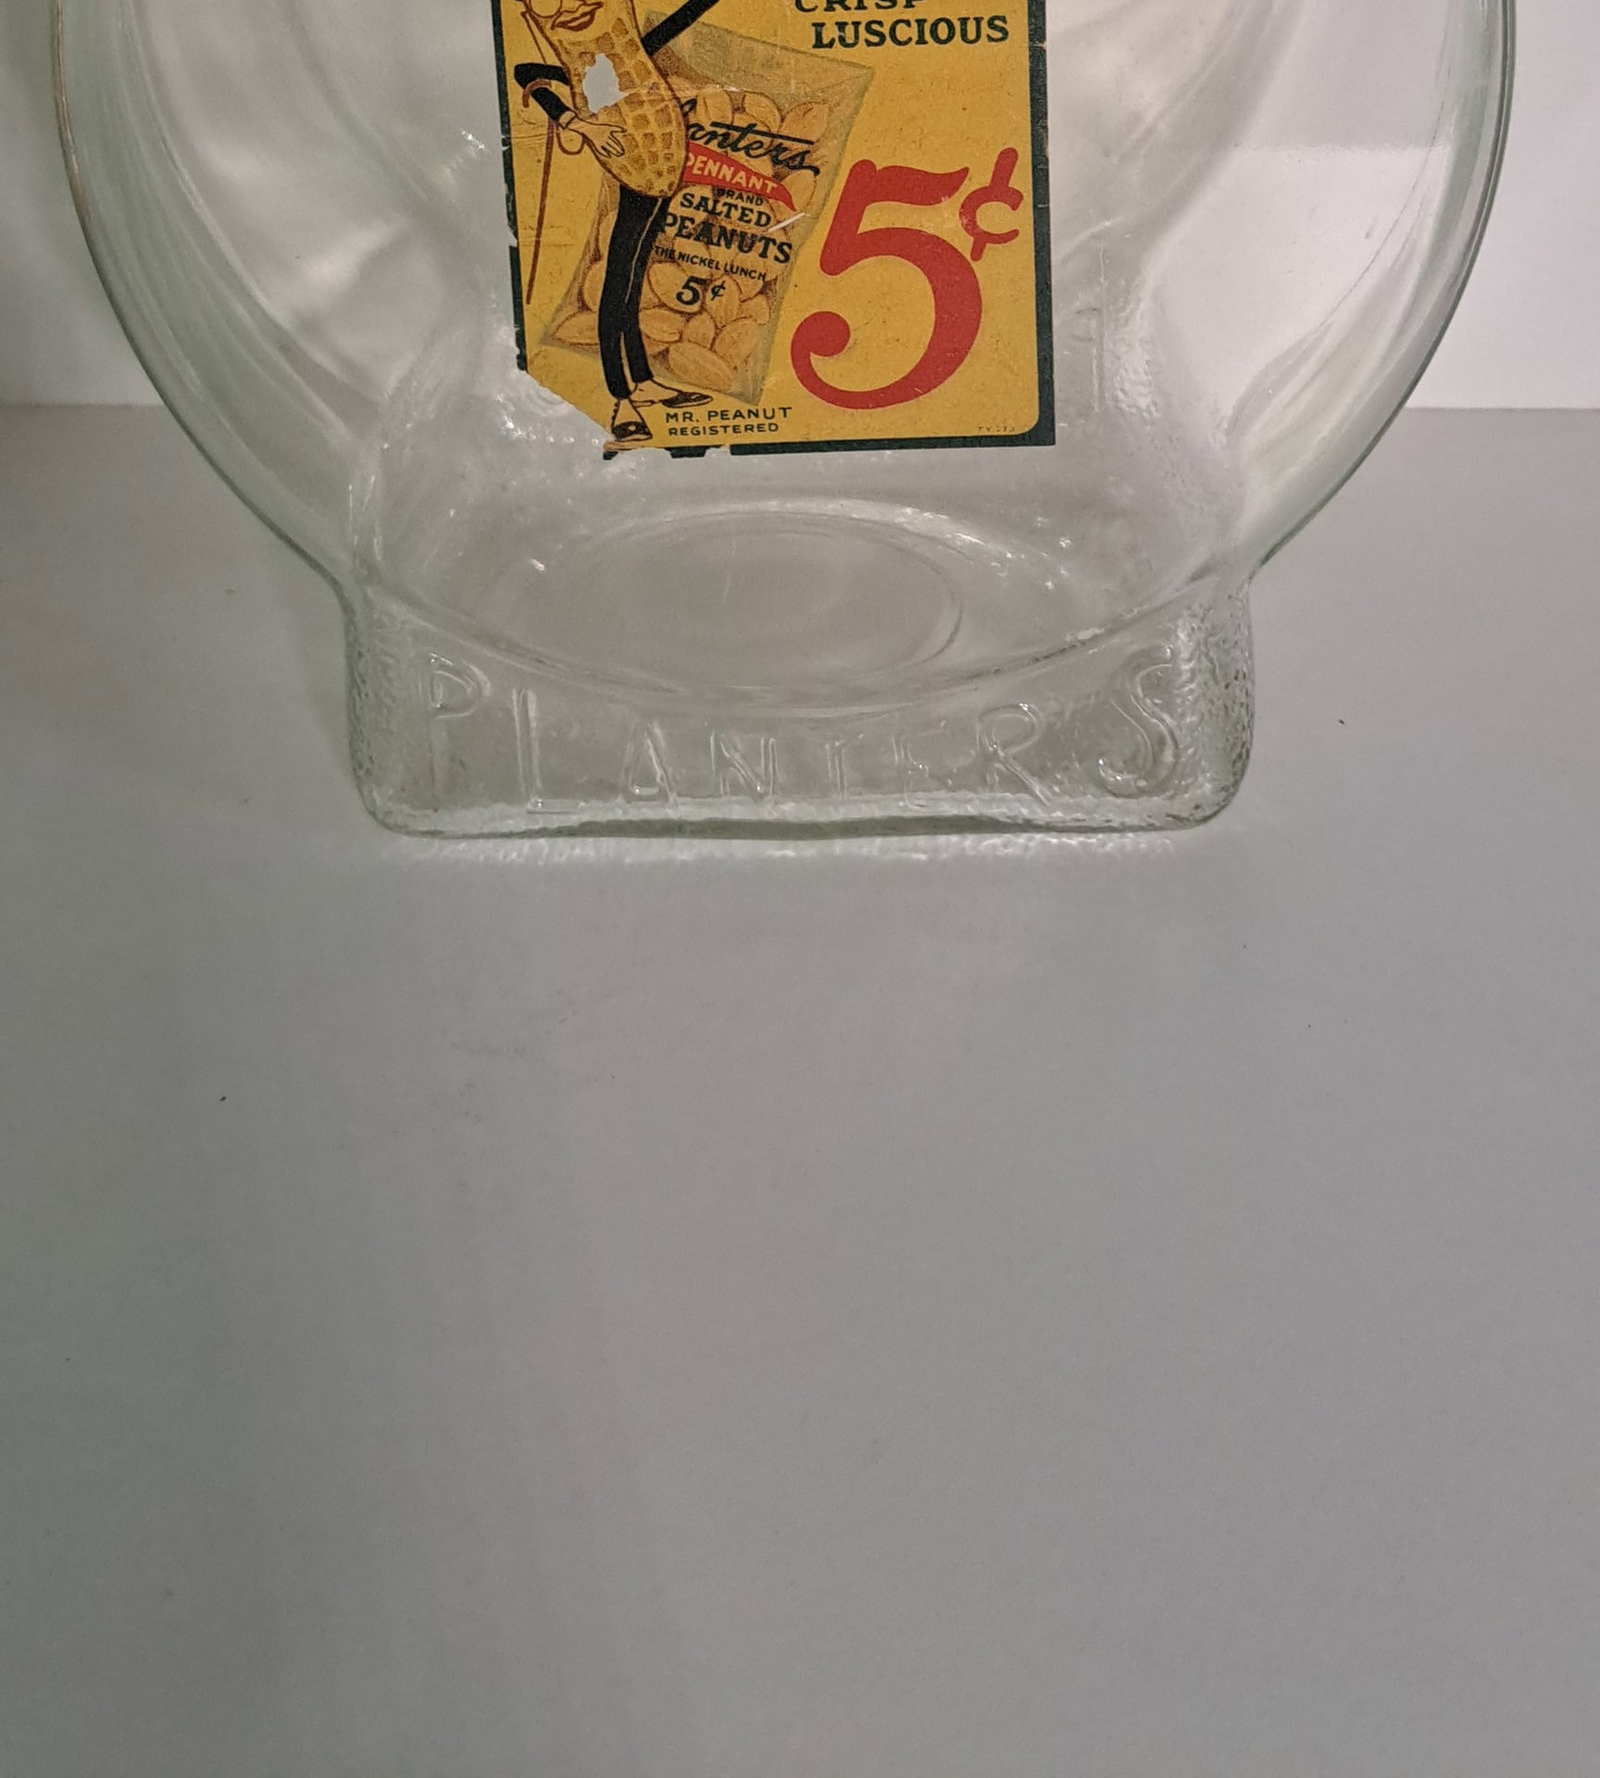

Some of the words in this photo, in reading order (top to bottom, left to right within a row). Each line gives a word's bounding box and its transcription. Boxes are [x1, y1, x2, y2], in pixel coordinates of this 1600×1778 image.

[812, 15, 1009, 49] LUSCIOUS
[679, 192, 772, 228] SALTED
[716, 188, 764, 207] BRAND
[660, 211, 793, 264] PEANUTS
[654, 245, 675, 260] THE
[677, 251, 721, 271] NICKEL
[724, 263, 767, 282] LUNCH
[665, 411, 700, 423] MR.
[707, 406, 793, 422] PEANUT
[668, 422, 780, 437] REGISTERED
